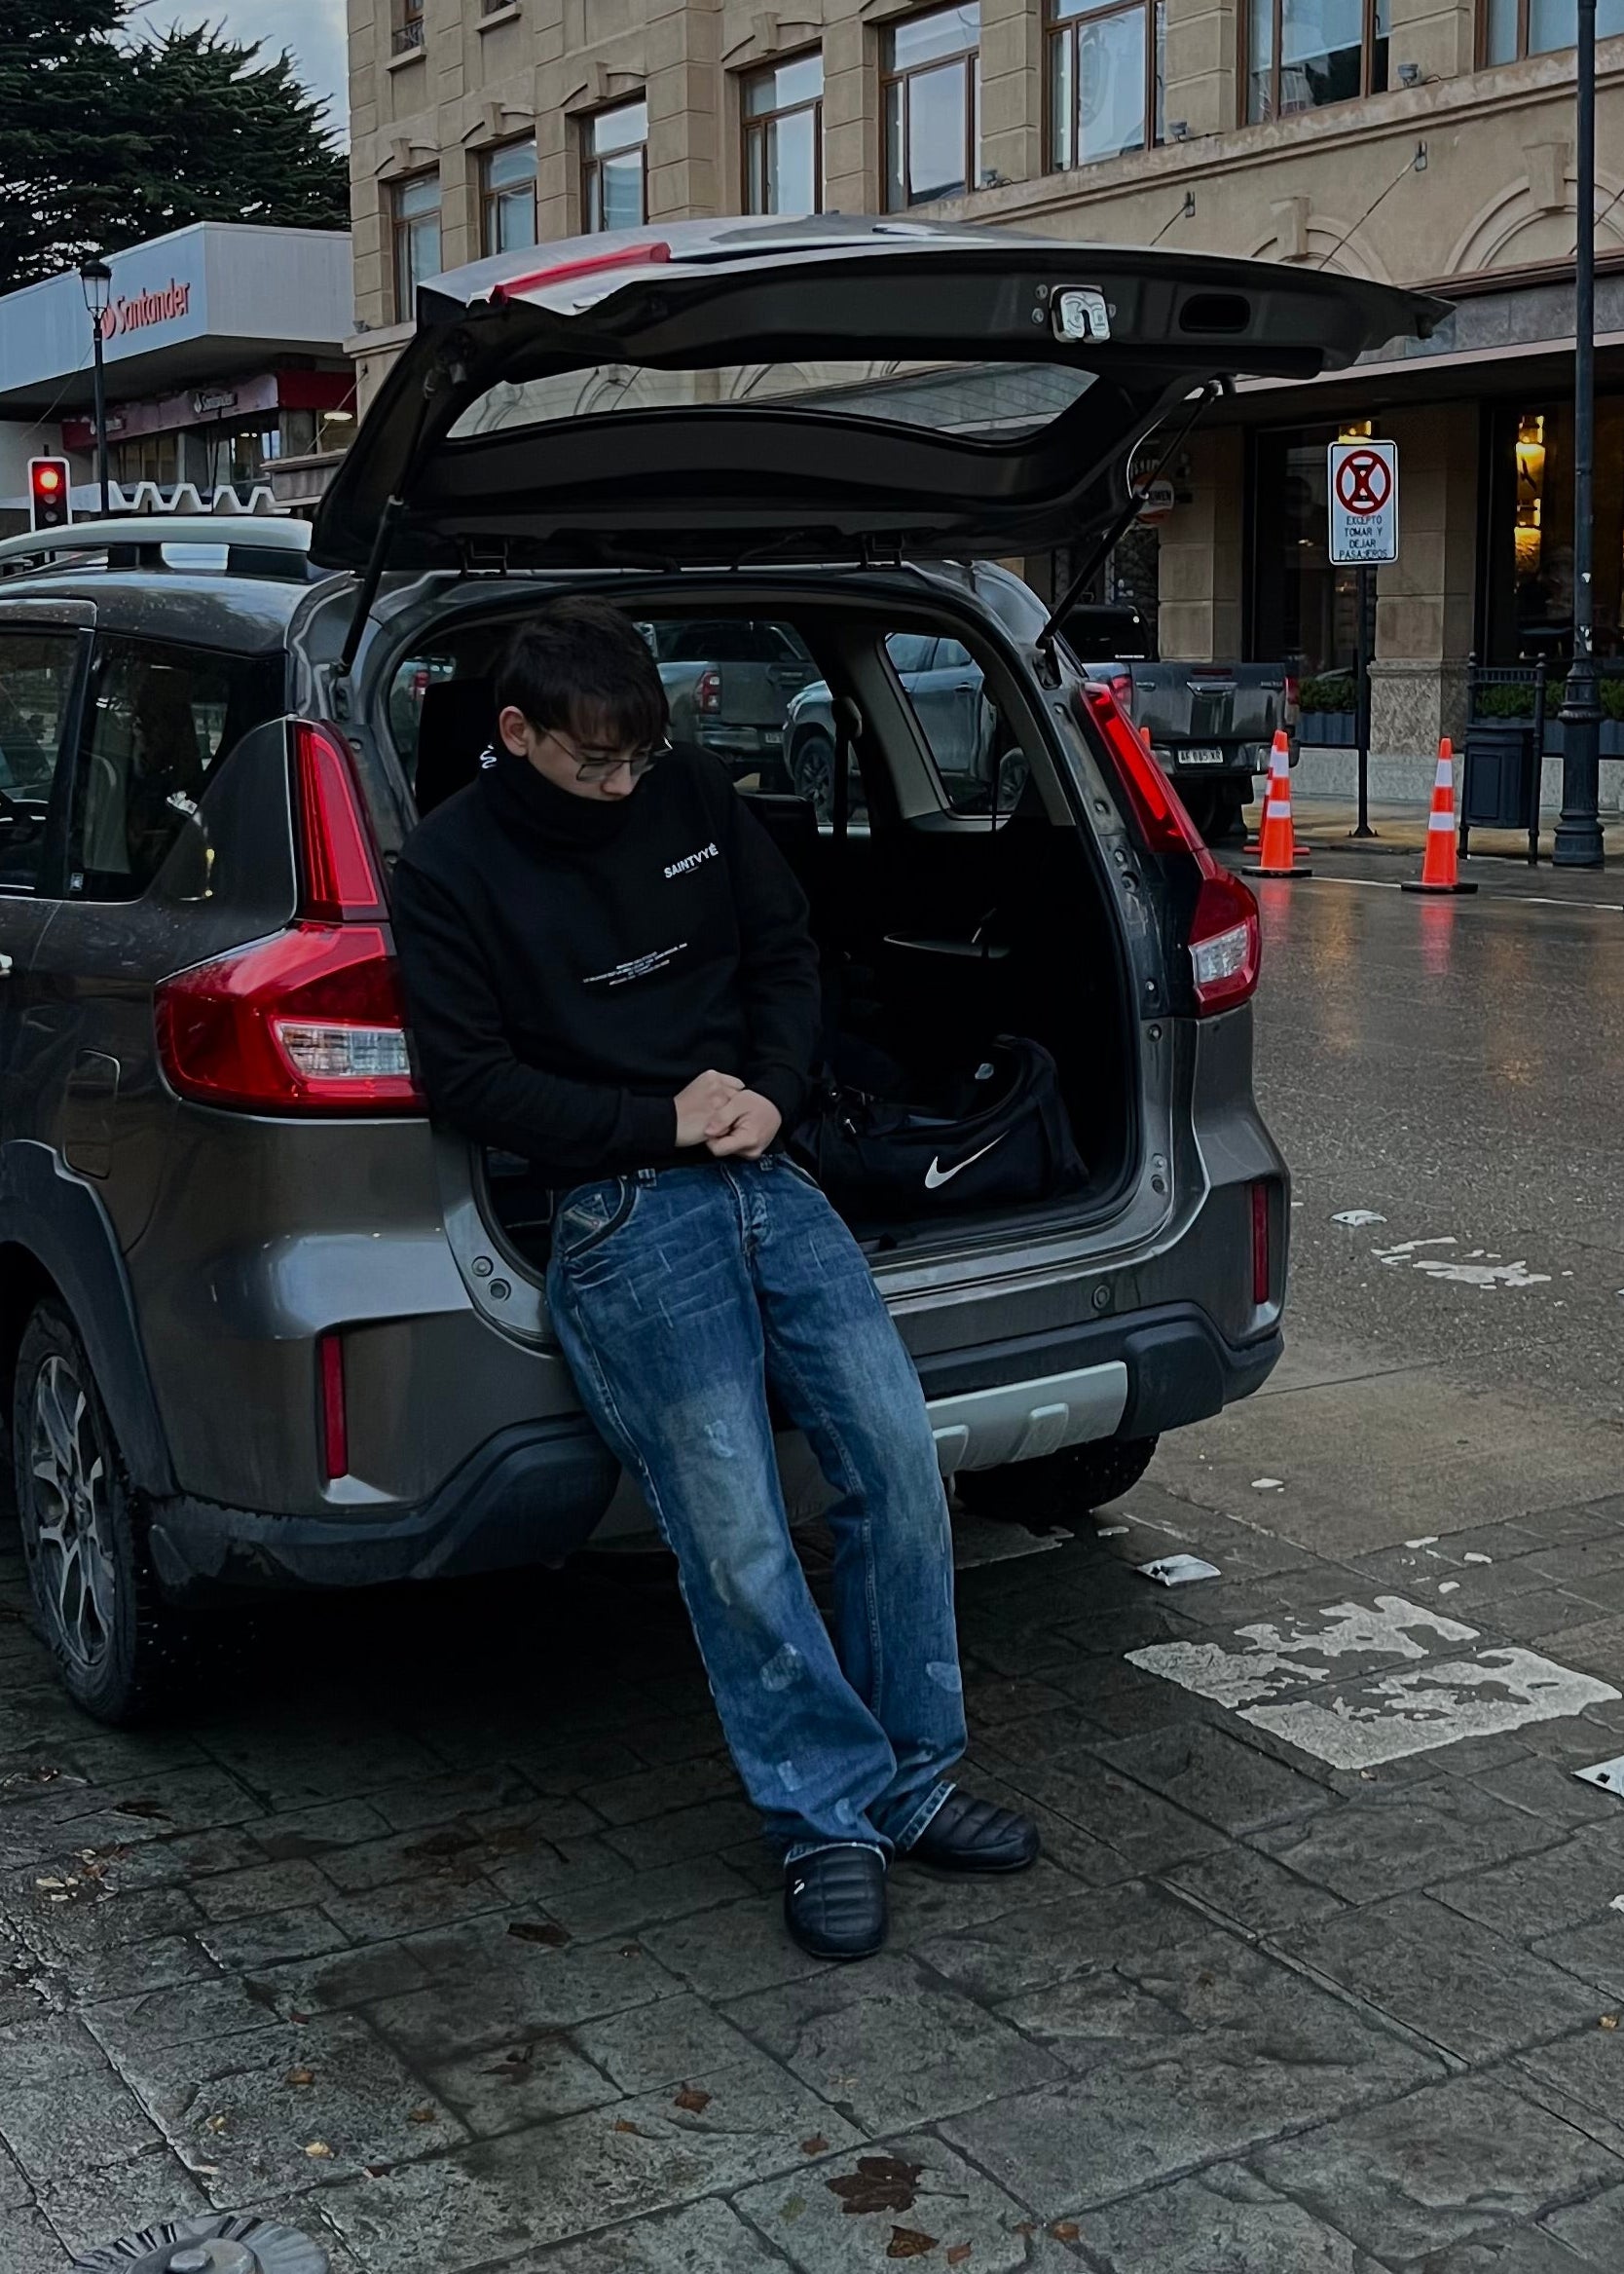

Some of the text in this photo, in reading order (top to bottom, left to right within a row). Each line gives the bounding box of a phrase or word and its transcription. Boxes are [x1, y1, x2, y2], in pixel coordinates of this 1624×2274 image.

[117, 278, 190, 335] Santander
[1347, 515, 1383, 525] EXCEPTO
[1345, 527, 1383, 537] TOMAR Y
[1349, 540, 1376, 548] DEJAR
